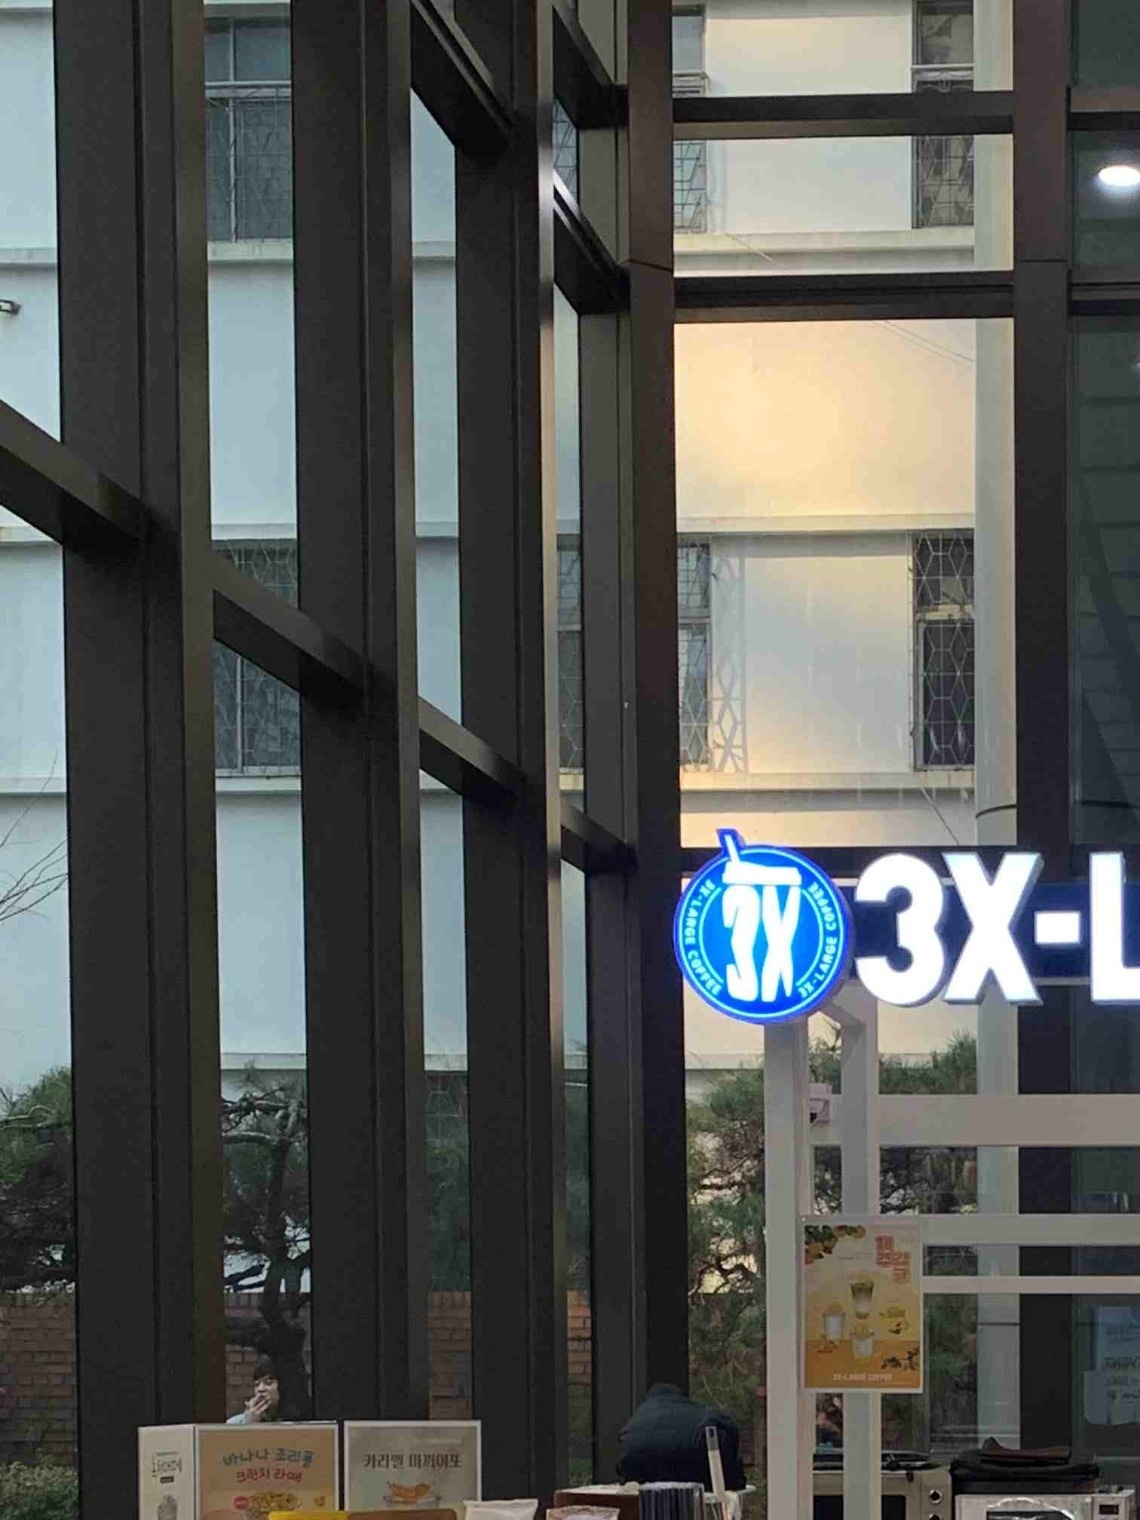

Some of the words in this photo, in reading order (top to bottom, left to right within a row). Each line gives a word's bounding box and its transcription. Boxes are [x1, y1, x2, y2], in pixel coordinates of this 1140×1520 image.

[222, 1448, 269, 1466] 바나나
[364, 1453, 404, 1469] 카라멜
[408, 1453, 463, 1469] 마끼아또
[236, 1468, 270, 1483] 크런치
